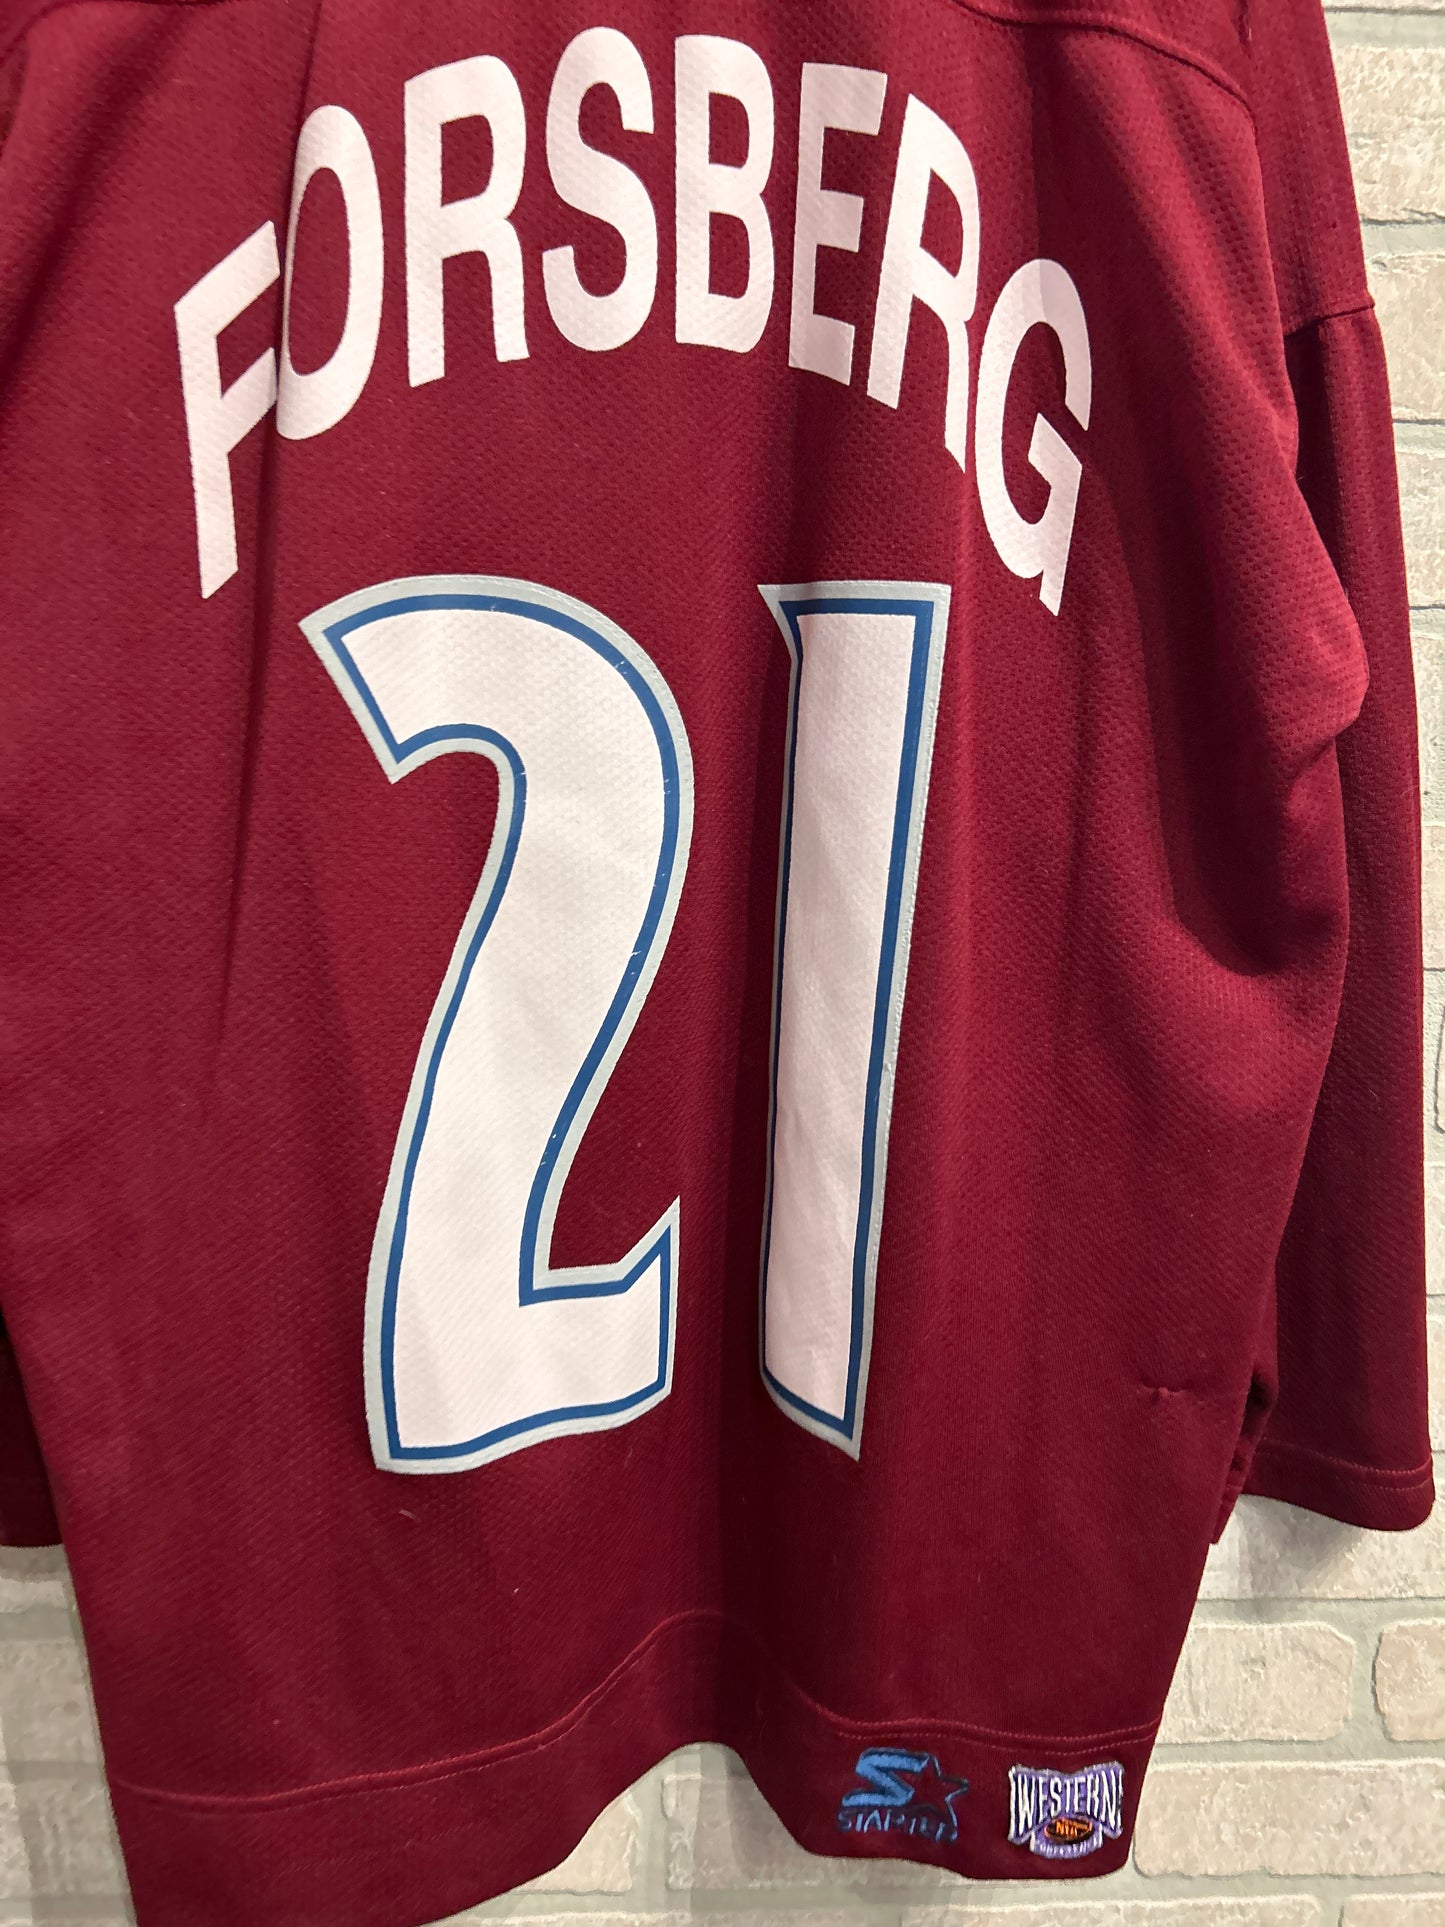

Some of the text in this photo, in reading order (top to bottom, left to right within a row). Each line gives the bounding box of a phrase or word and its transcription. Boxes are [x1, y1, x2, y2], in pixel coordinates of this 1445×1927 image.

[174, 27, 1092, 616] FORSBERG
[300, 575, 951, 1475] 21
[1017, 1769, 1119, 1835] WESTERN
